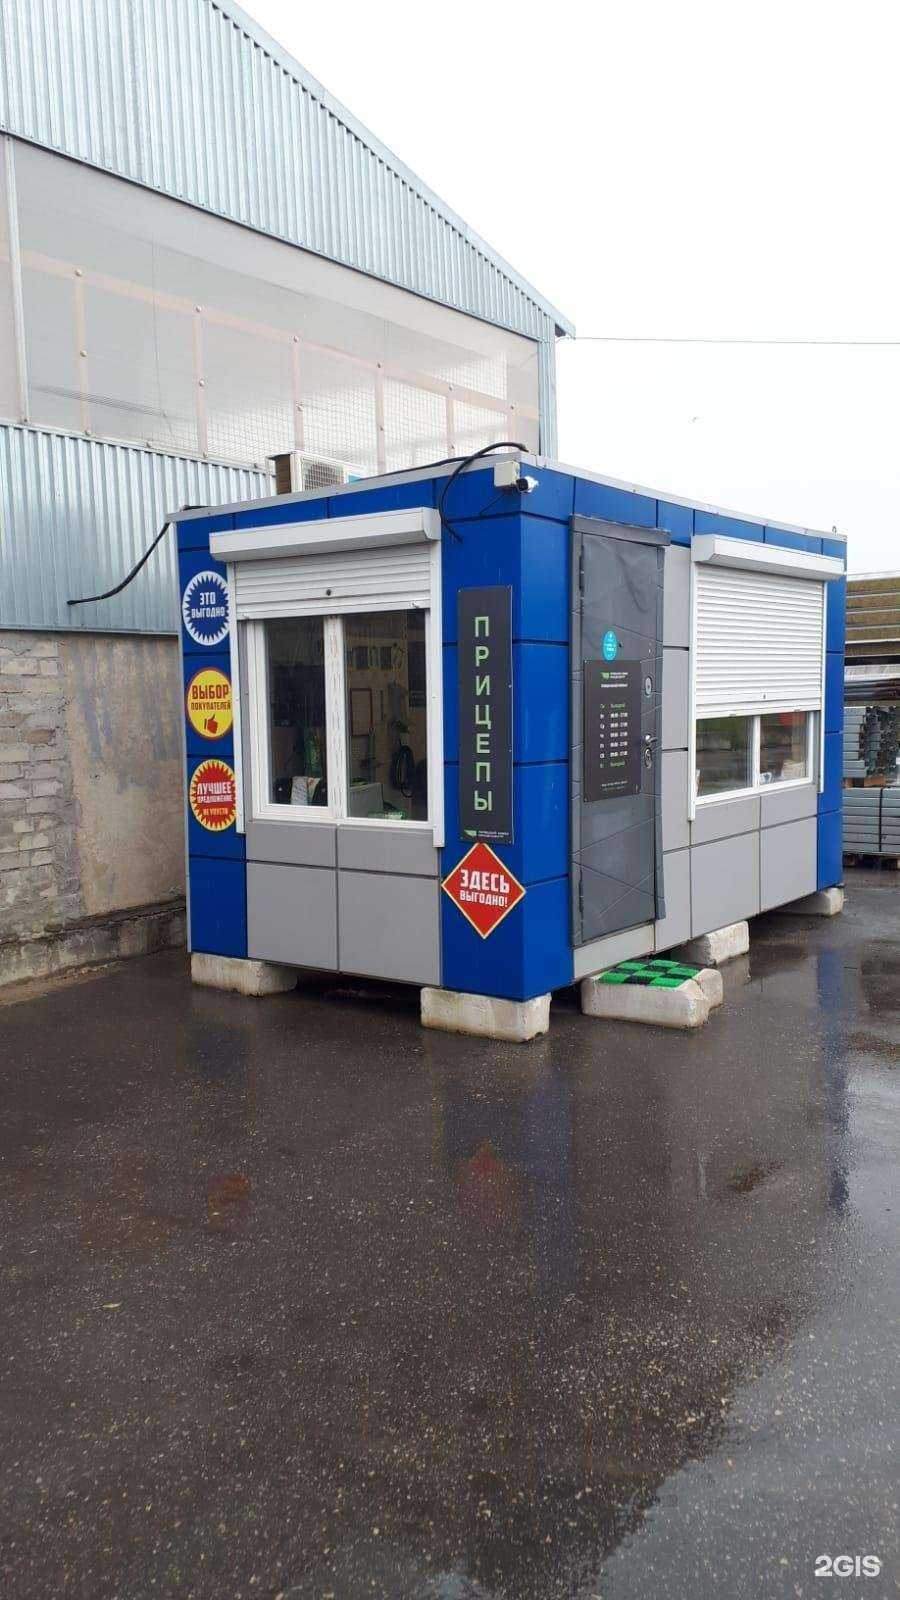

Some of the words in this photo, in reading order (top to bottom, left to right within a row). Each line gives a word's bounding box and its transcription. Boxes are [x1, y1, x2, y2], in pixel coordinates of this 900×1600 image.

[199, 591, 217, 606] ЭТО
[191, 606, 226, 619] ВЫГОДНО
[191, 684, 229, 700] ВЫБОР
[473, 615, 493, 813] ПРИЦЕПЫ
[196, 781, 232, 796] ЛУЧШЕЕ
[460, 869, 510, 894] ЗДЕСЬ
[459, 889, 508, 908] ВЫГОДНО!
